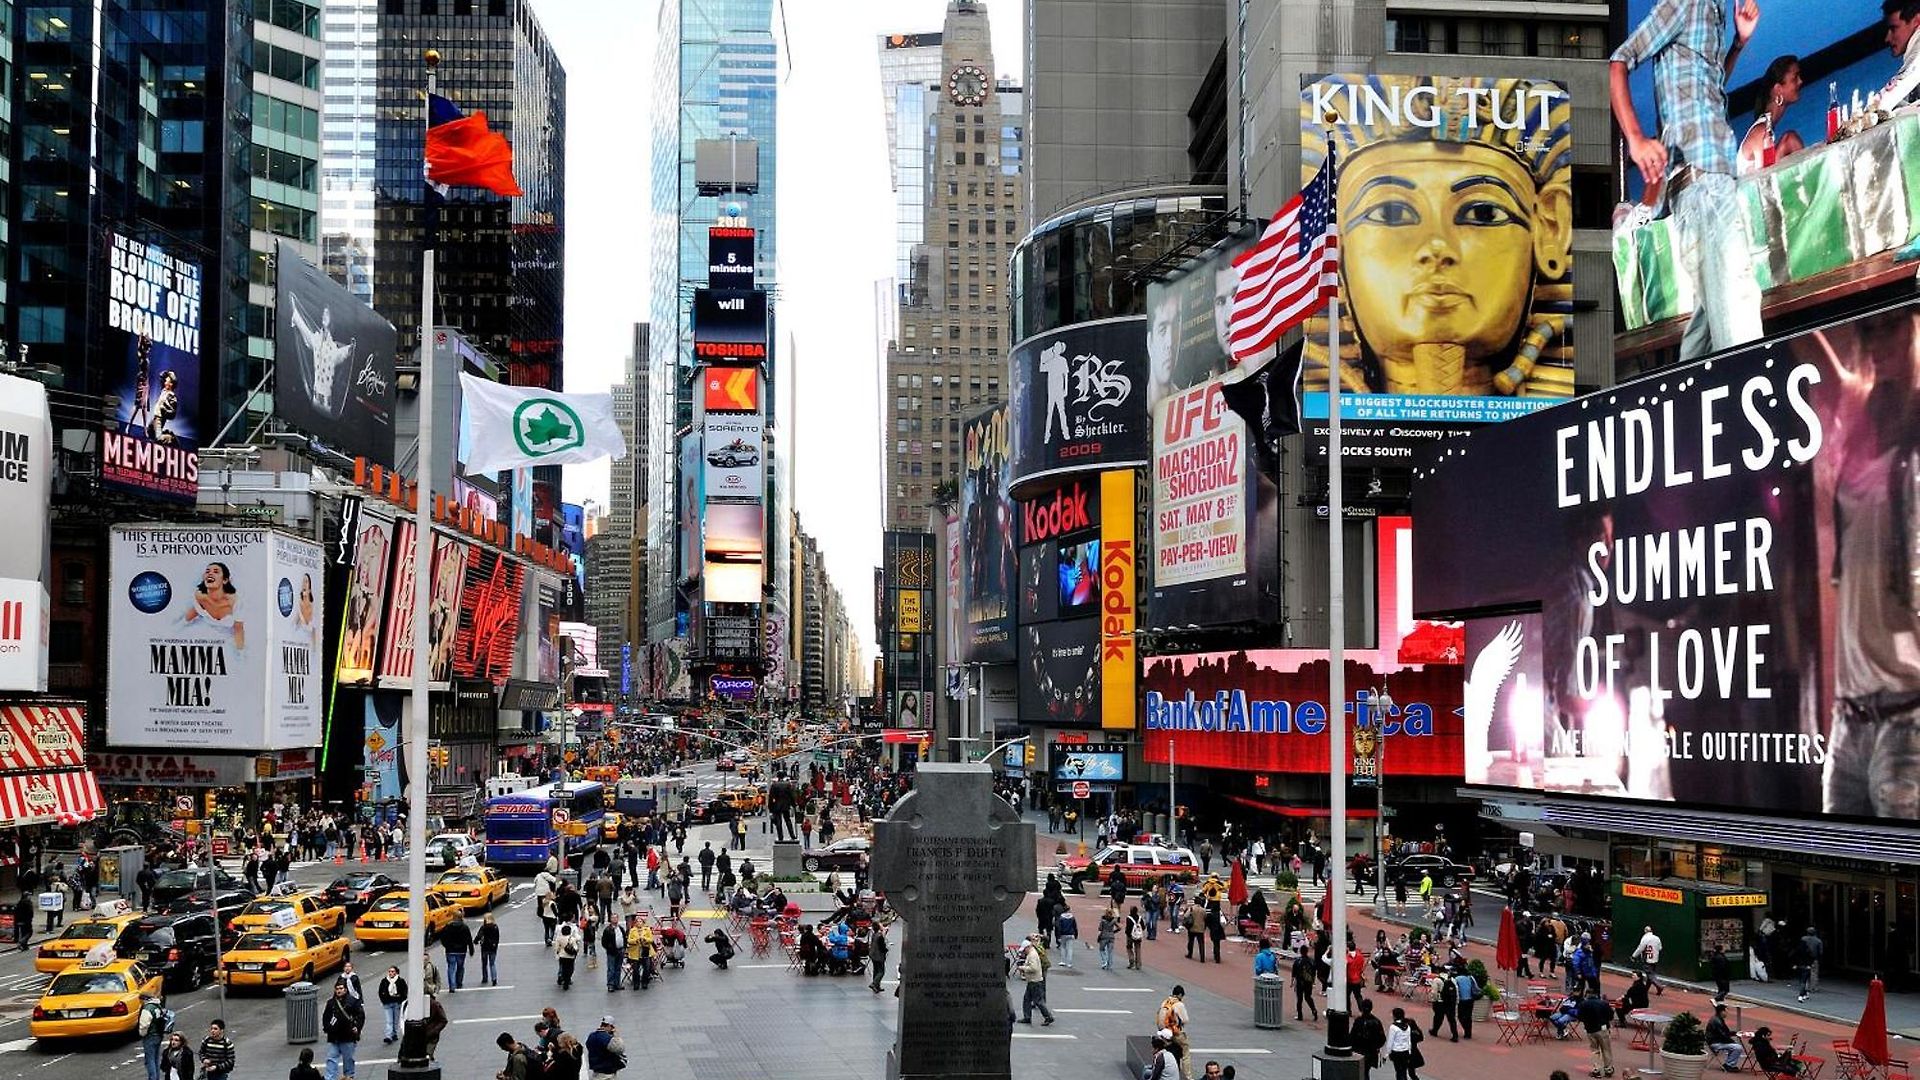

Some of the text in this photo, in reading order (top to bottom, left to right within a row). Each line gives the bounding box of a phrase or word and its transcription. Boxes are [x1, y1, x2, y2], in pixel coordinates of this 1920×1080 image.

[1311, 83, 1562, 131] KING TUT
[710, 228, 755, 238] TOSHIBA
[114, 233, 129, 250] THE
[129, 237, 145, 256] NEW
[146, 243, 174, 270] MUSICAL
[728, 252, 737, 264] 5
[110, 245, 201, 301] BLOWING THE
[710, 264, 755, 274] minutes
[109, 267, 201, 329] ROOF OFF
[717, 298, 745, 310] will
[108, 298, 201, 356] BROADWAY!
[696, 343, 766, 357] TOSHIBA
[1071, 352, 1132, 422] RS
[1164, 381, 1225, 446] UFC
[1339, 397, 1352, 407] HE
[1354, 397, 1402, 408] BIGGEST
[1404, 398, 1486, 409] BLOCKBUSTER
[1357, 408, 1373, 417] OF
[1375, 408, 1398, 418] ALL
[1400, 409, 1428, 419] TIME
[1429, 409, 1482, 421] RETURNS
[1484, 410, 1499, 420] TO
[1075, 422, 1123, 439] Sheckler
[1313, 427, 1372, 437] EXCSIVELY
[1373, 428, 1385, 437] AT
[1393, 427, 1444, 441] Discovery
[1556, 362, 1823, 508] ENDLESS
[103, 430, 199, 484] MEMPHIS
[1059, 442, 1104, 458] 2009
[1159, 437, 1228, 481] MACHIDA
[1318, 446, 1412, 457] 2 OCKS SOUTH
[1169, 461, 1229, 502] SHOGUN
[1023, 482, 1089, 543] Kodak
[1160, 509, 1183, 534] SAT.
[1186, 501, 1213, 526] MAY
[1217, 498, 1225, 519] 8
[137, 543, 147, 555] IS
[150, 544, 159, 555] A
[150, 531, 212, 544] FEEL-GOOD
[216, 532, 265, 544] MUSICAL
[1160, 533, 1239, 568] PAY-PER-VIEW
[1587, 516, 1776, 607] SUMMER
[901, 605, 918, 616] LION
[1104, 539, 1131, 662] Kodak
[900, 617, 919, 627] KING
[149, 644, 228, 676] MAMMA
[282, 646, 310, 676] MAMMA
[1576, 623, 1773, 702] OF LOVE
[165, 676, 212, 707] MIA!
[287, 677, 305, 705] MIA!
[711, 679, 754, 689] YAHOO!
[1145, 687, 1201, 733] Bank
[1200, 690, 1229, 735] of
[87, 754, 196, 769] DIGITAL
[1550, 728, 1631, 759] AMEN
[1701, 731, 1827, 765] OUTFITTERS
[1353, 757, 1376, 767] KING
[1353, 766, 1376, 777] TUT
[967, 847, 1007, 859] DUFFY
